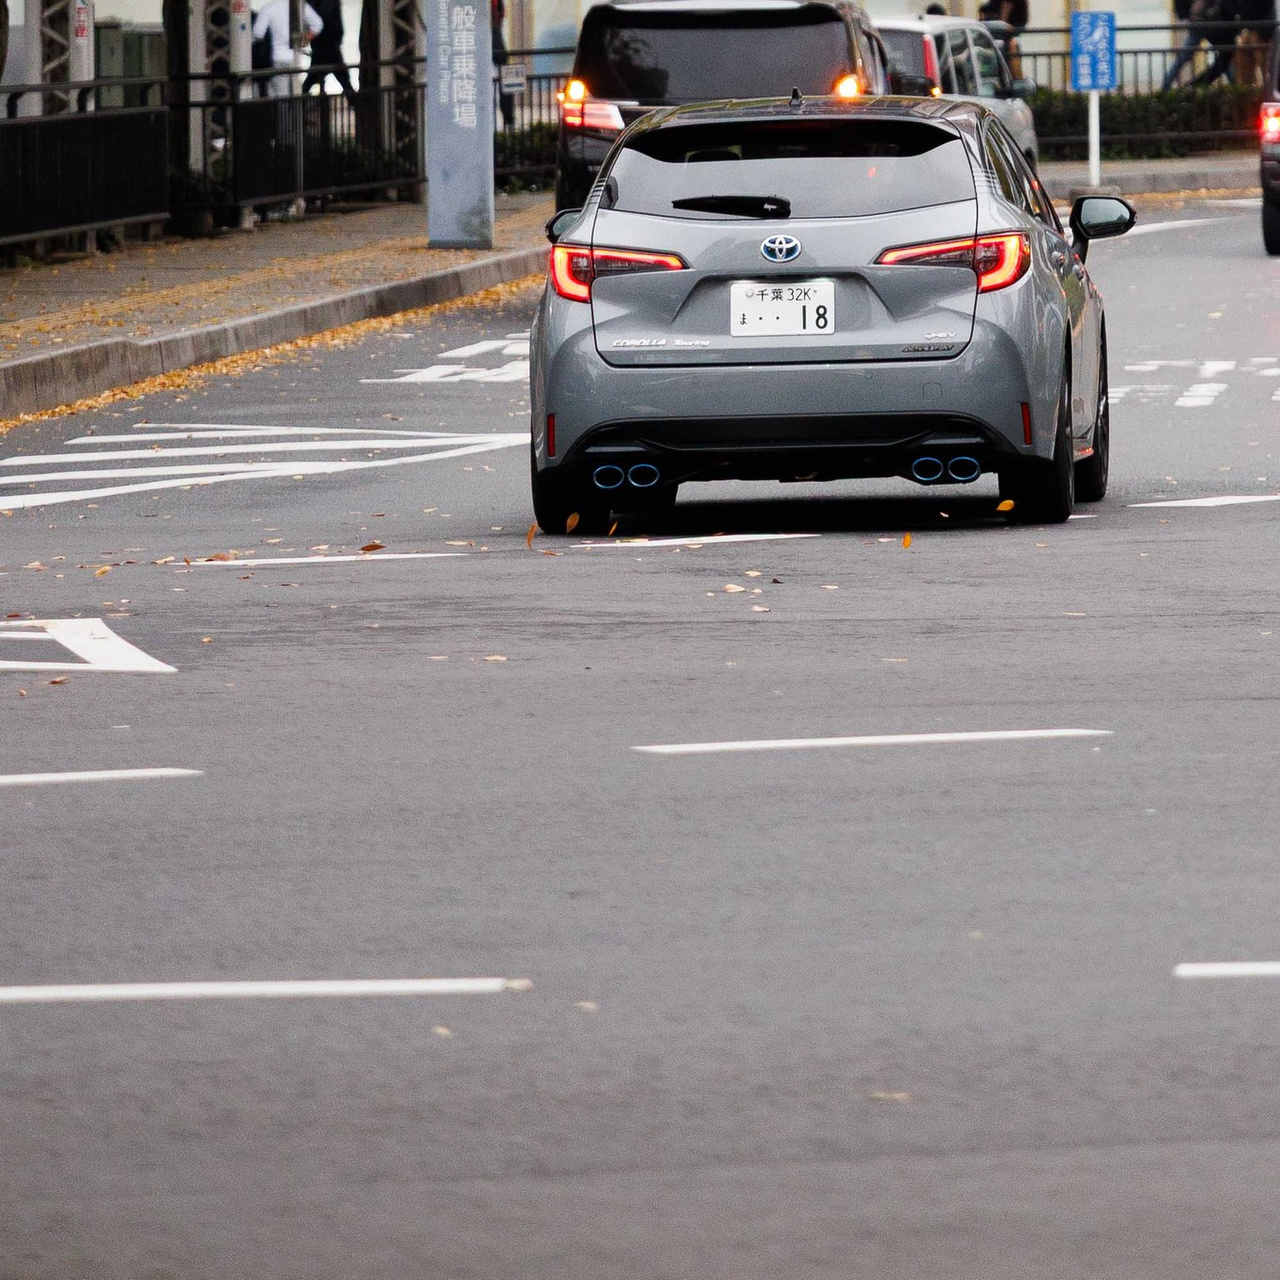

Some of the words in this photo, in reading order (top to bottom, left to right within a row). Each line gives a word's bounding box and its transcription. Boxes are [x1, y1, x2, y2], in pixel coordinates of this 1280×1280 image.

[756, 288, 784, 301] 千葉
[787, 288, 812, 301] 32K
[612, 339, 667, 347] COROLLA
